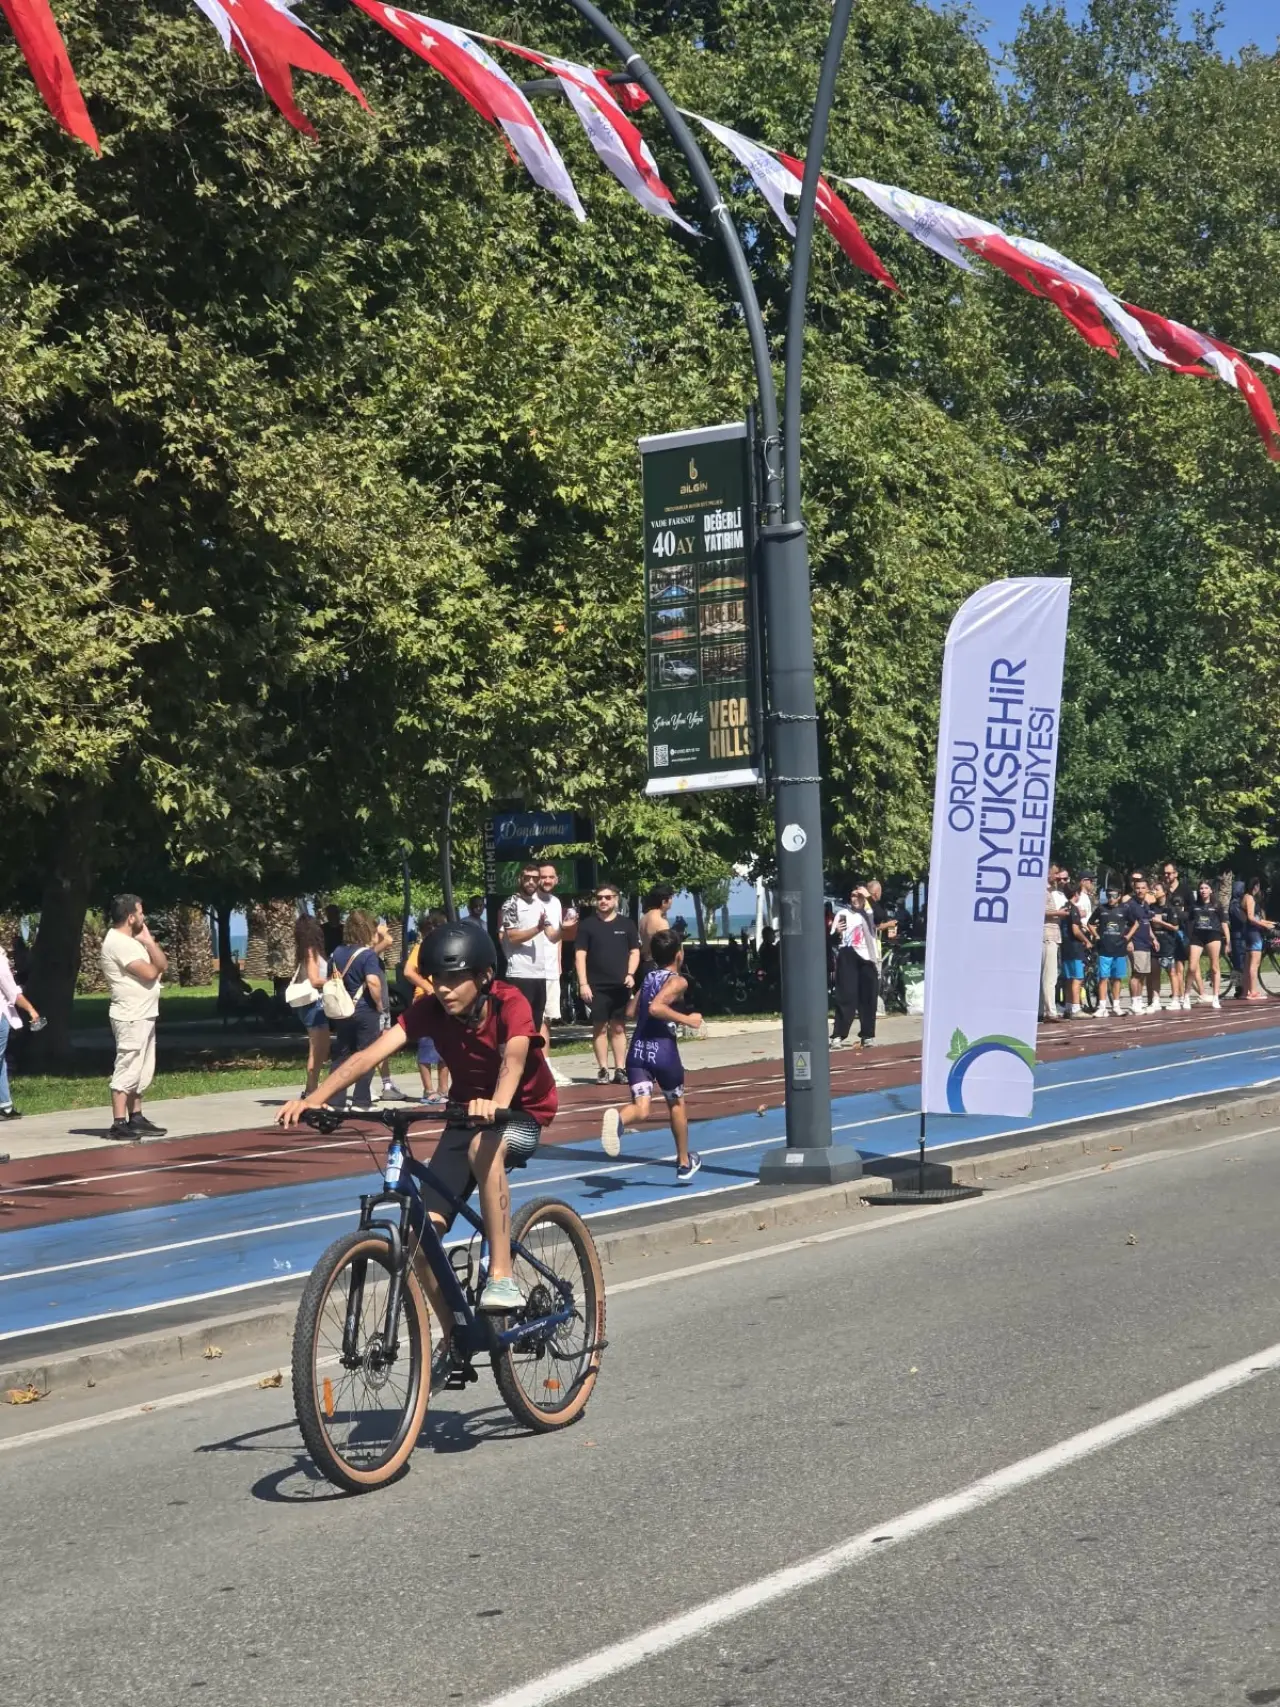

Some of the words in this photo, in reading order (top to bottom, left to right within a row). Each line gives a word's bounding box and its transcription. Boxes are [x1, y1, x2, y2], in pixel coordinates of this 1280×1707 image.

[651, 519, 667, 528] VADE
[668, 515, 696, 526] FARKSIZ
[704, 507, 741, 532] DEĞERLİ
[652, 530, 676, 557] 40
[676, 536, 696, 555] AY
[704, 530, 744, 552] YATIRIM
[708, 698, 749, 729] VEGA
[709, 727, 754, 759] HILLS
[948, 741, 979, 832] ORDU
[974, 658, 1027, 924] BÜYÜKŞEHİR
[1017, 706, 1055, 878] BELEDİYESİ
